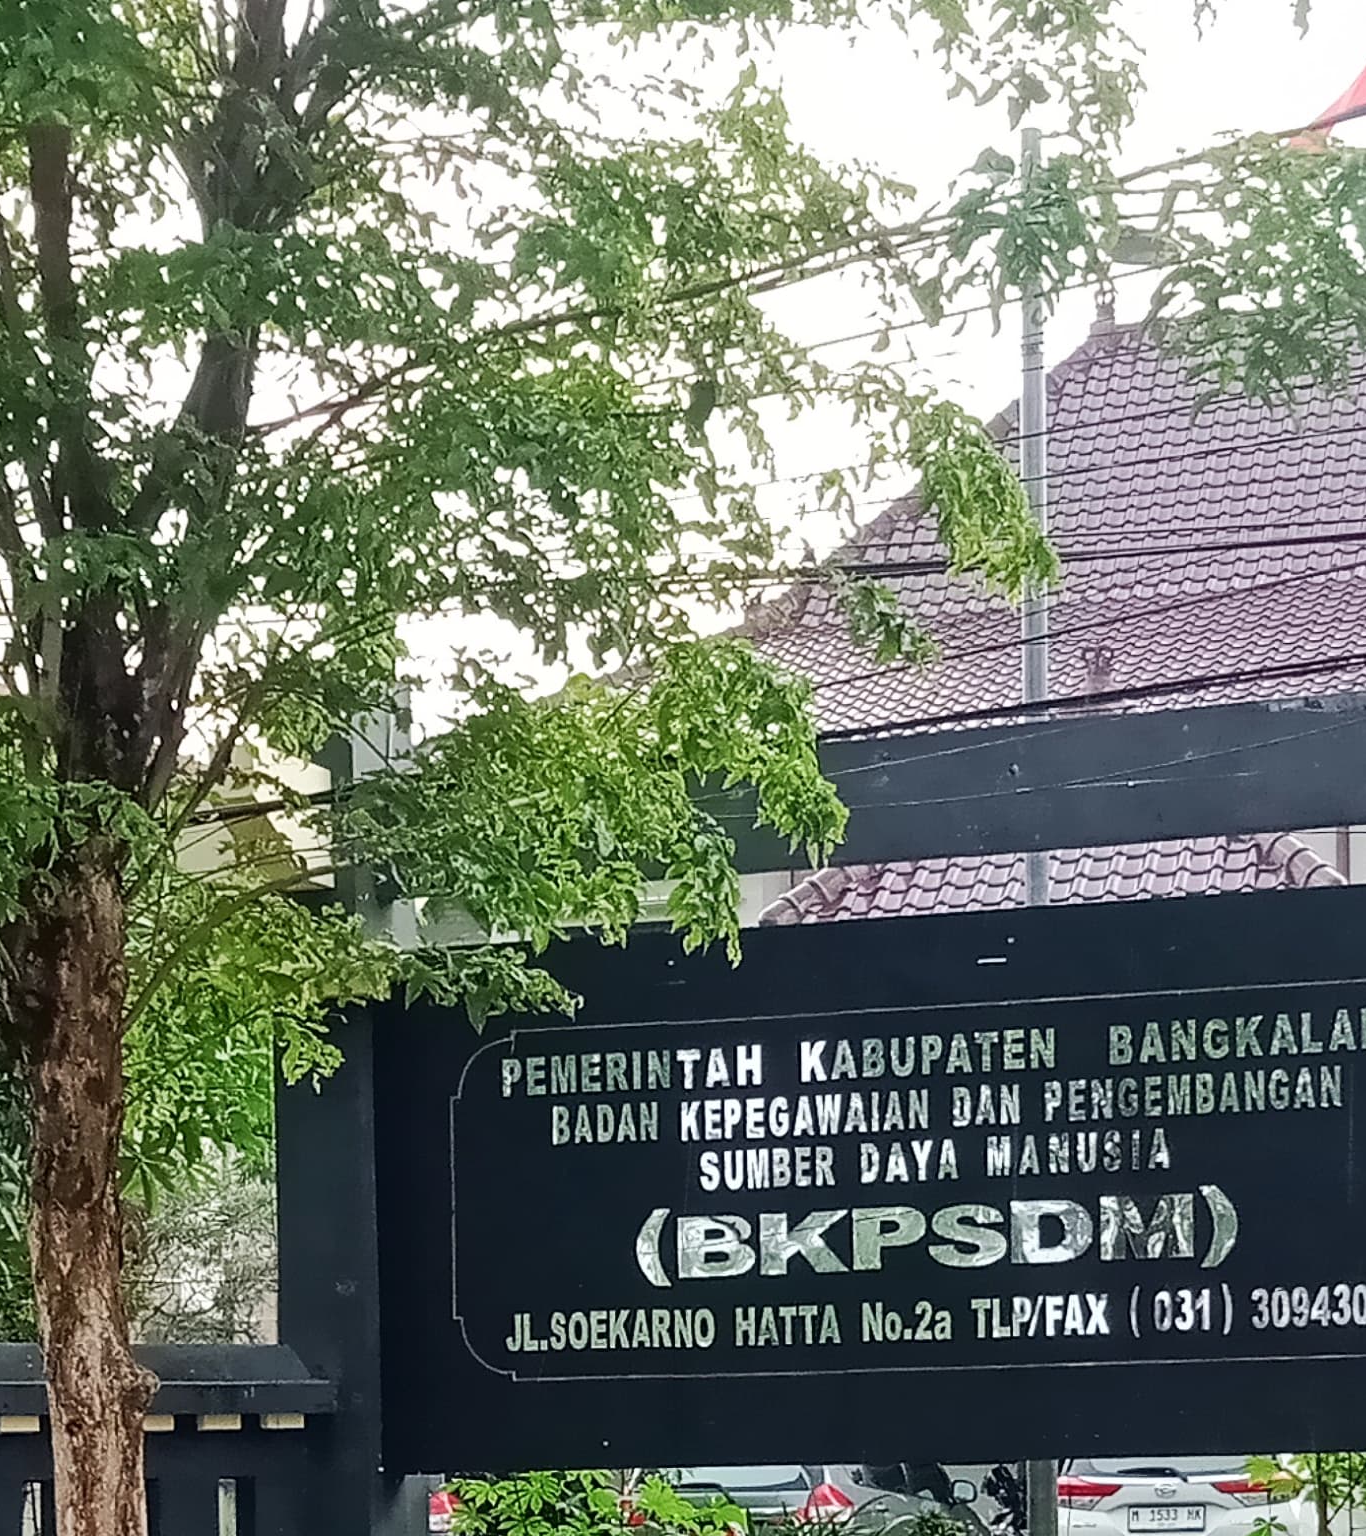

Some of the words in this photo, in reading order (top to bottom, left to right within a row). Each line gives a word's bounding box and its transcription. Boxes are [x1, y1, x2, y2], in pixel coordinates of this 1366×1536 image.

[502, 1044, 763, 1099] PEMERINTAH
[800, 1027, 1056, 1084] KABUPATEN
[551, 1102, 659, 1146] BADAN
[680, 1089, 930, 1142] KEPEGAWAIAN
[952, 1083, 1021, 1128] DAN
[1043, 1065, 1344, 1122] PENGEMBANGAN
[699, 1145, 836, 1192] SUMBER
[860, 1138, 959, 1184] DAYA
[986, 1127, 1171, 1177] MANUSIA
[635, 1184, 1239, 1287] (BKPSDM)
[505, 1308, 716, 1352] JL.SOEKARNO
[735, 1304, 842, 1347] HATTA
[861, 1300, 952, 1343] No.2a
[970, 1293, 1111, 1339] TLP/FAX
